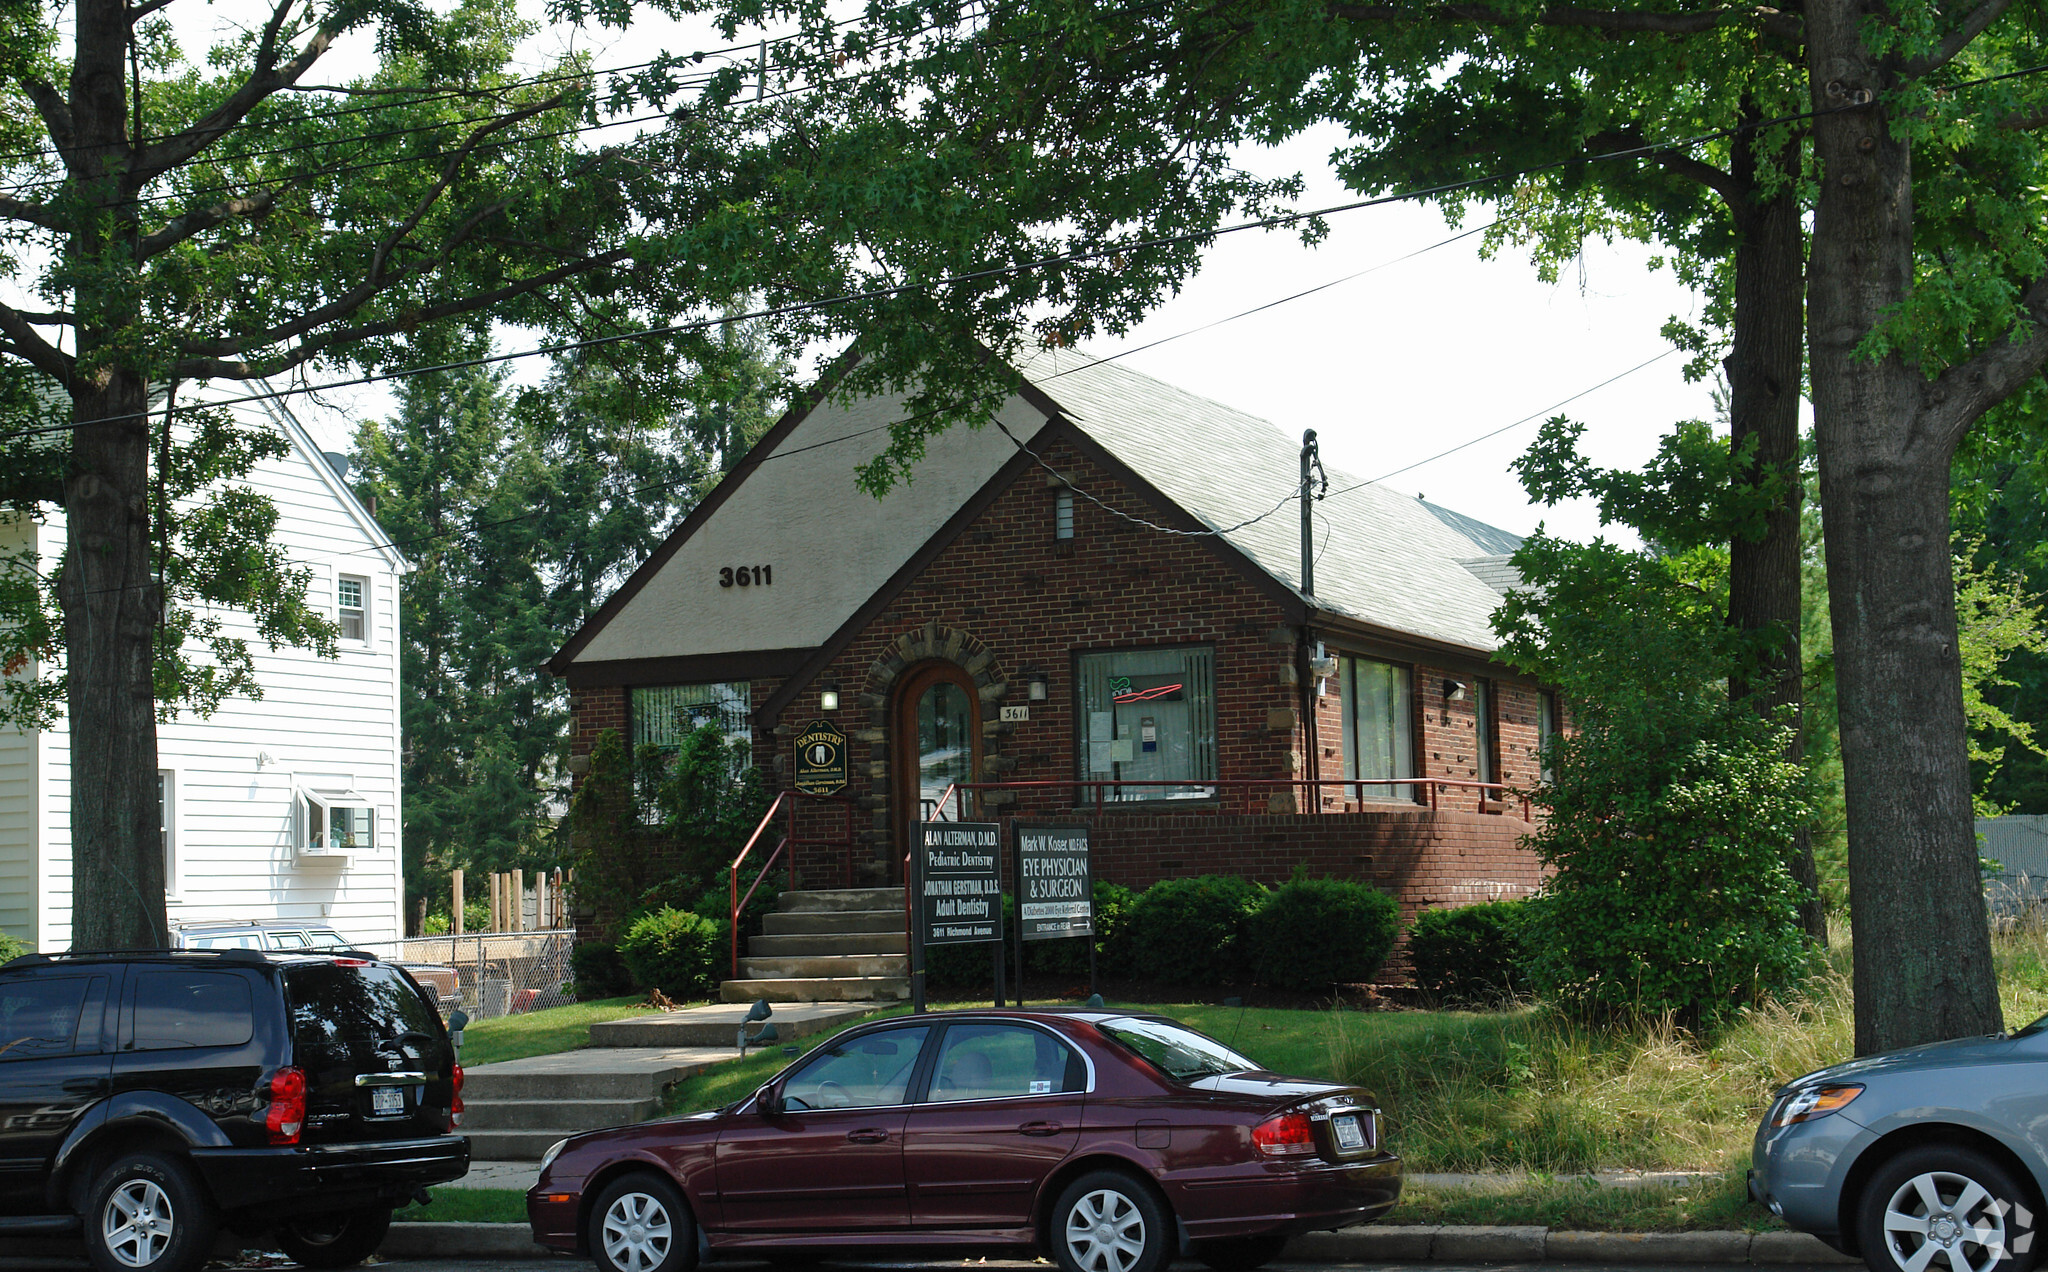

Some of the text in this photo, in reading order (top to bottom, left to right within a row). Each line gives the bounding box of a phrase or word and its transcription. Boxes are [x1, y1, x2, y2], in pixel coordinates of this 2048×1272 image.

[719, 564, 772, 588] 3611
[797, 732, 844, 748] DENTISTRY
[925, 831, 998, 849] ALAN ALTERMAN, D.M.D.
[1021, 835, 1038, 851] Mark
[1023, 857, 1088, 877] EYE PHYSICIAN
[924, 880, 953, 896] JONATHAN
[1030, 878, 1082, 898] & SURGEON
[936, 898, 989, 918] Adult Dentistry
[932, 926, 992, 938] 3611 Richmond Avenue
